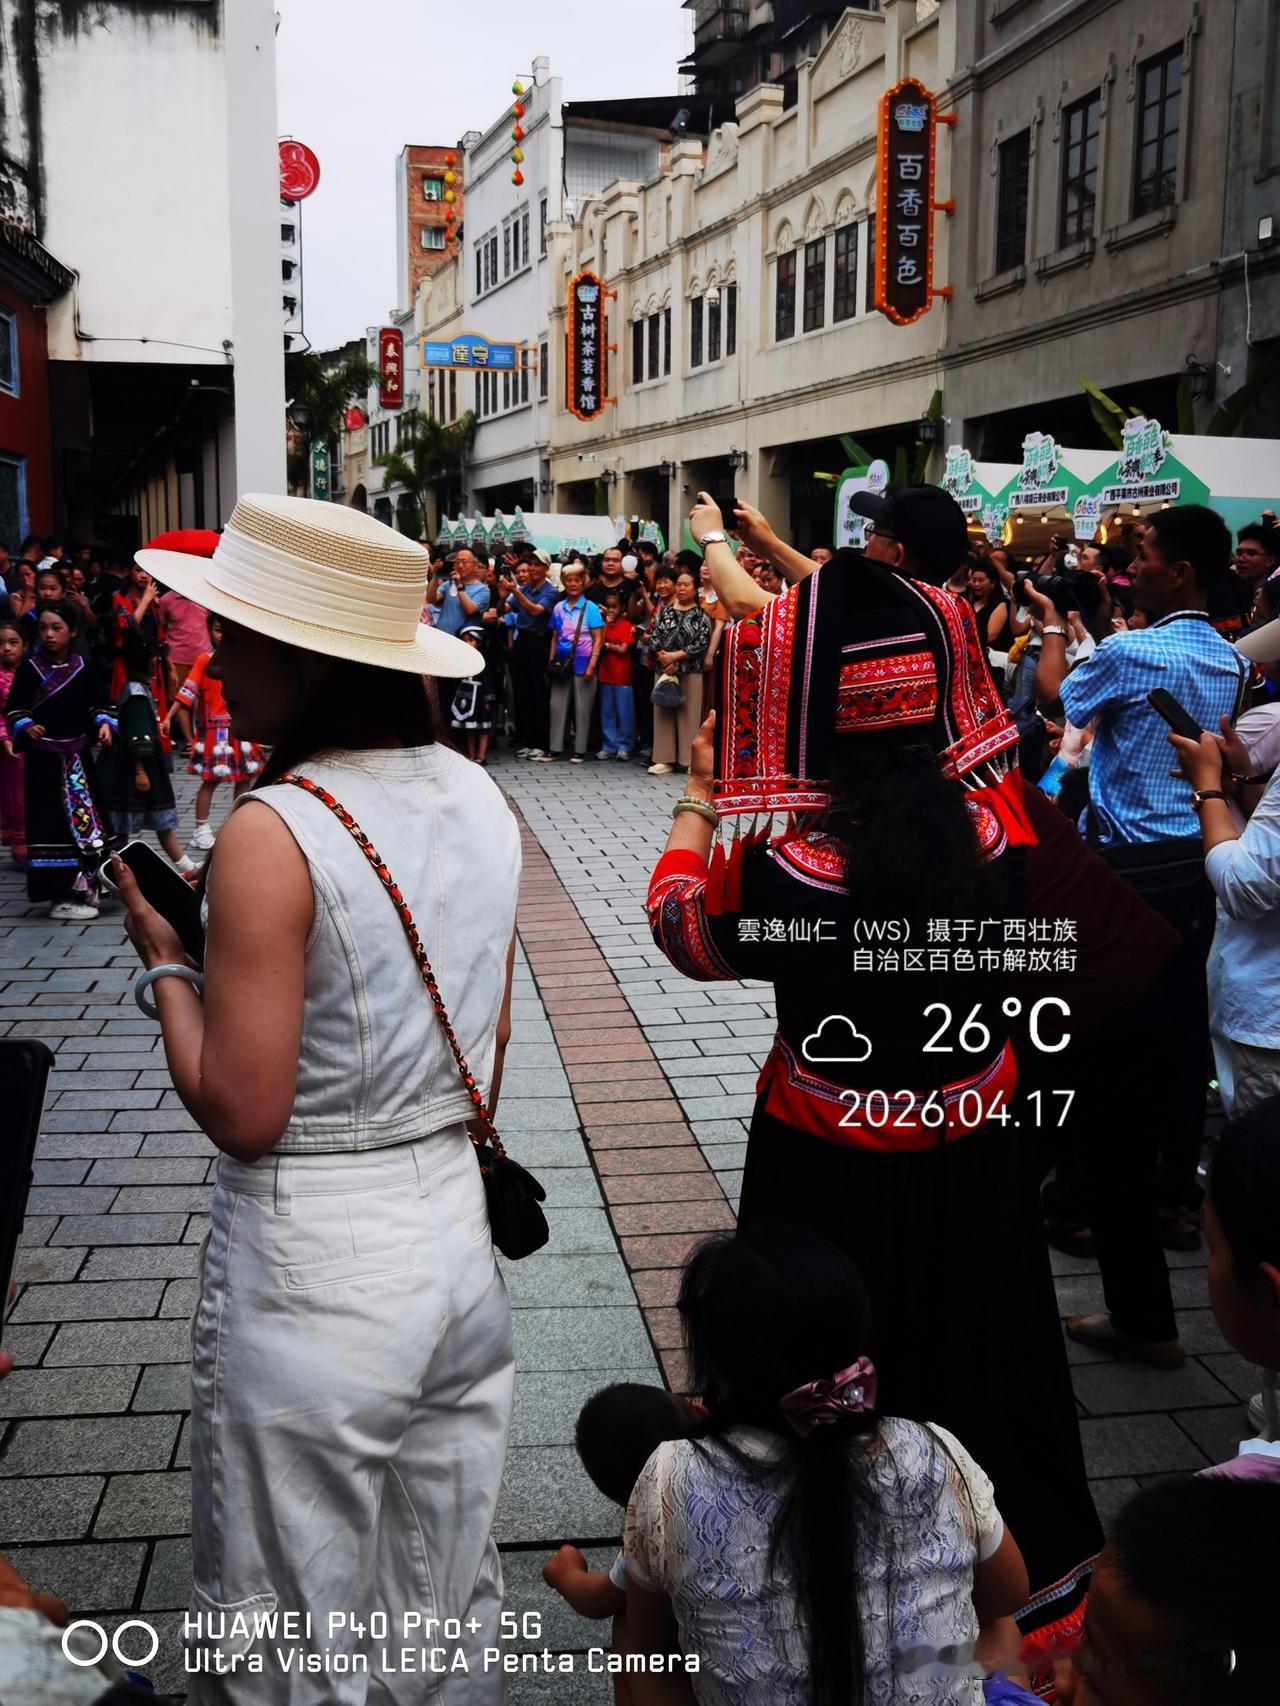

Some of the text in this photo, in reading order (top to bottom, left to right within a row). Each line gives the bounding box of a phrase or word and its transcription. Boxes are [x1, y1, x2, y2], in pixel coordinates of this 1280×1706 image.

[896, 154, 924, 285] 百香百色
[580, 304, 597, 410] 古树茶茗香馆
